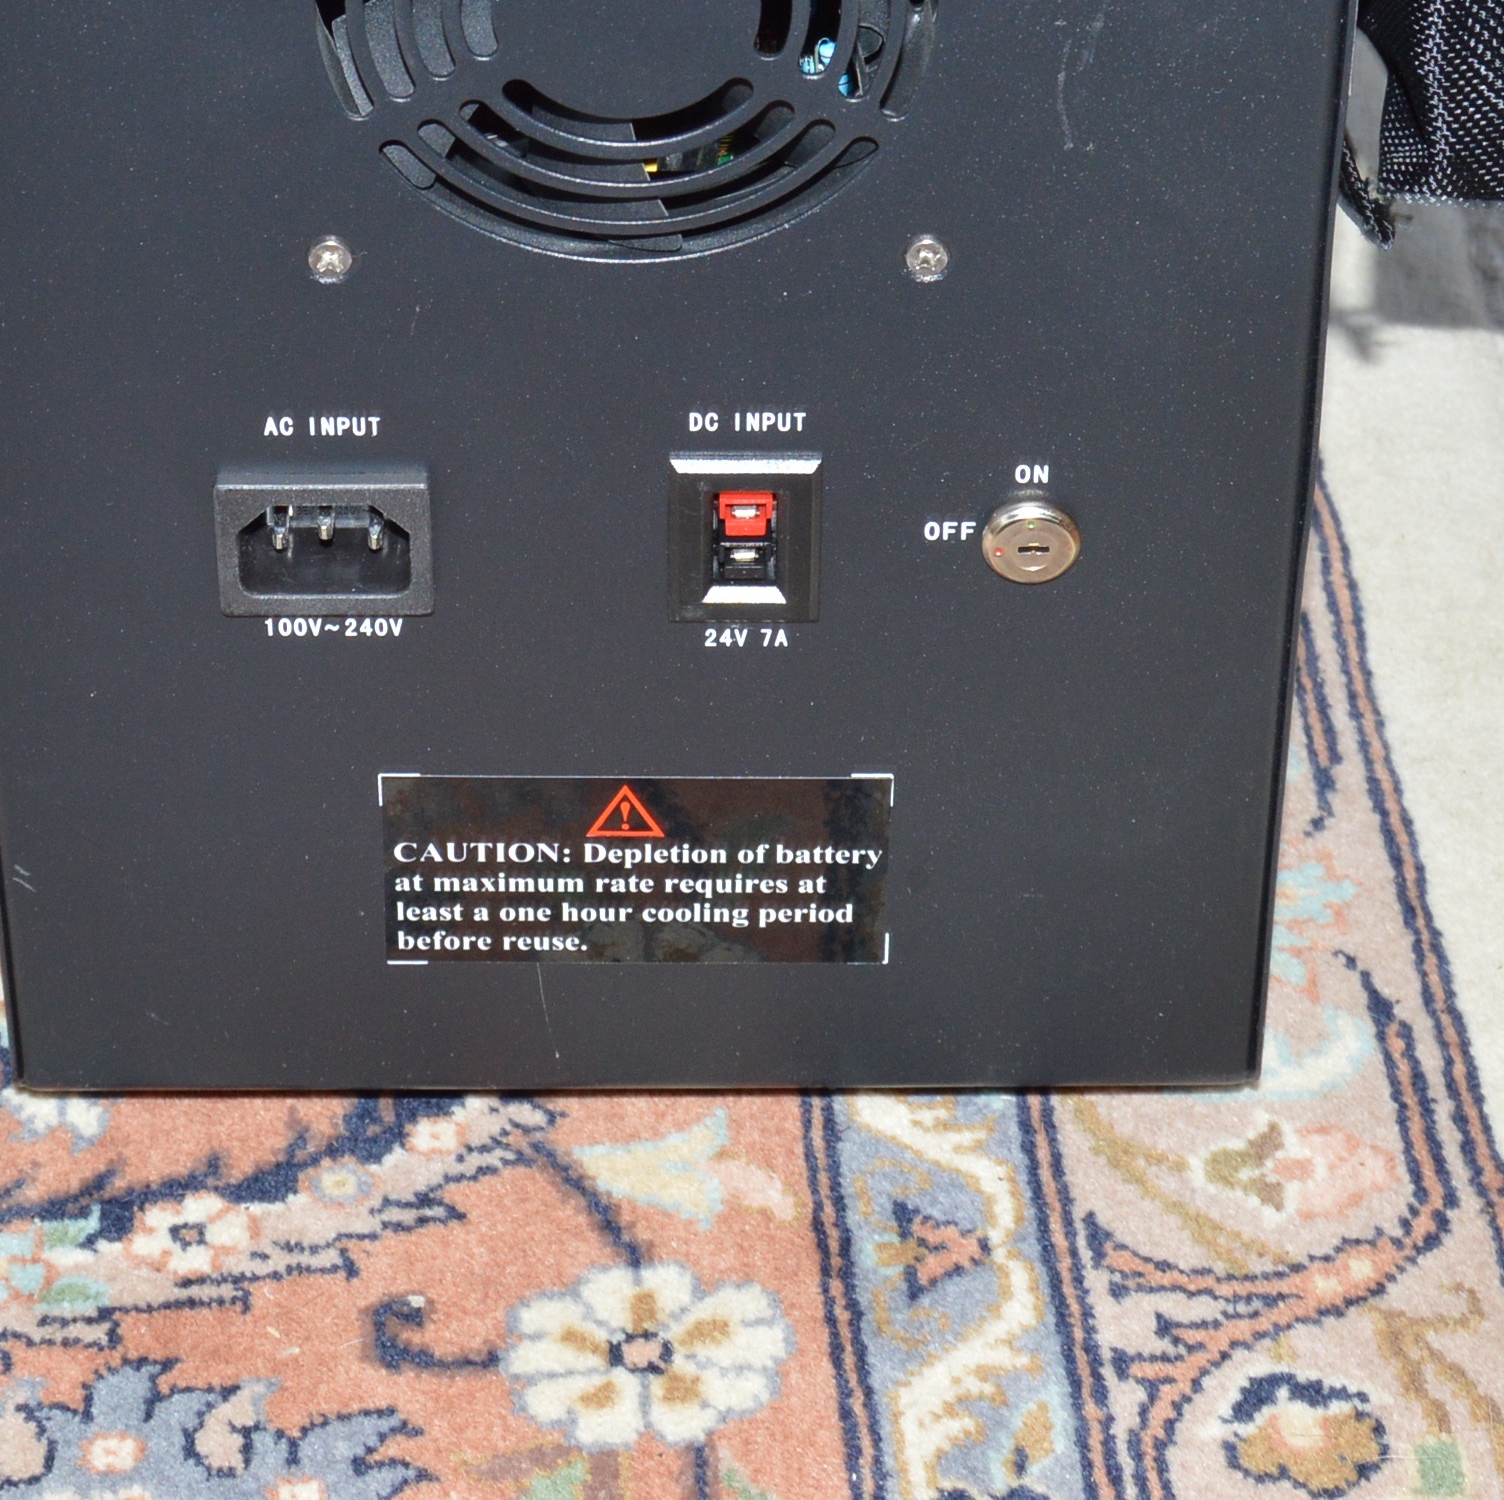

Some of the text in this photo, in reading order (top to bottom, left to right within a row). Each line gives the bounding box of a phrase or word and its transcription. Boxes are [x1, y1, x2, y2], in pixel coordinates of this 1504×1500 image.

[263, 416, 381, 437] AC INPUT
[688, 411, 807, 432] DC INPUT
[1014, 464, 1050, 484] ON
[923, 521, 977, 541] OFF
[264, 617, 403, 637] 100V~240V
[704, 628, 789, 648] 24V 7A
[393, 841, 883, 870] CAUTION: Depletion of battery
[394, 872, 827, 899] at maximum rate requires at
[396, 901, 853, 928] least a one hour cooling period
[397, 930, 588, 952] before reuse.
